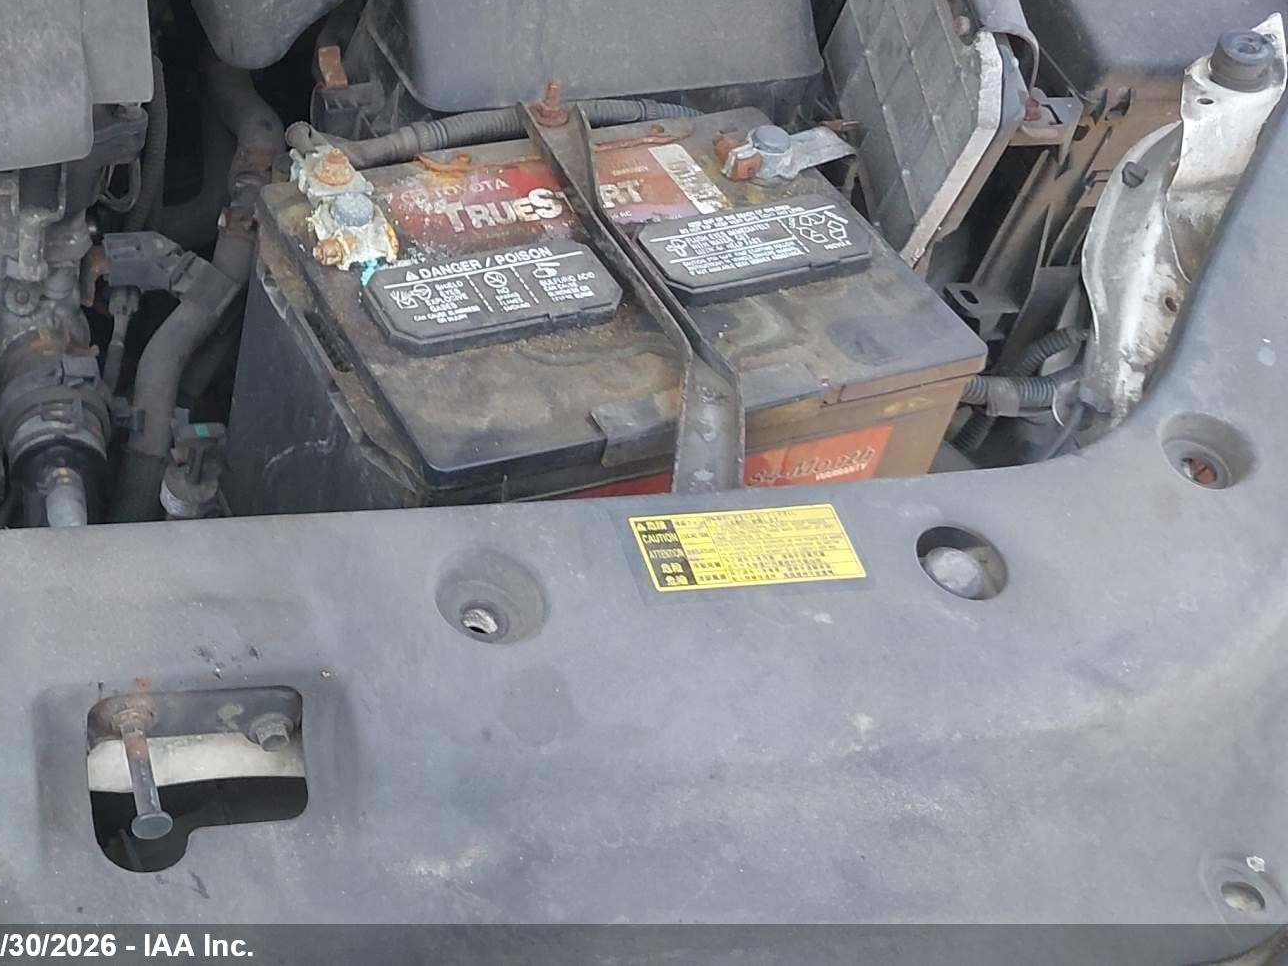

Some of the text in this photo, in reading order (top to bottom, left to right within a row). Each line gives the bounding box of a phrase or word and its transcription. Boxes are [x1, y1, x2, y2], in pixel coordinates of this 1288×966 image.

[436, 177, 510, 198] TOYOTA
[419, 246, 553, 279] DANGER / POISON
[575, 271, 595, 280] ACID
[434, 280, 464, 290] SHIELD
[439, 288, 461, 297] EYES
[496, 287, 510, 295] NO
[424, 293, 469, 306] EXPLOSIVE
[429, 302, 458, 312] GASES
[642, 532, 679, 543] CAUTION
